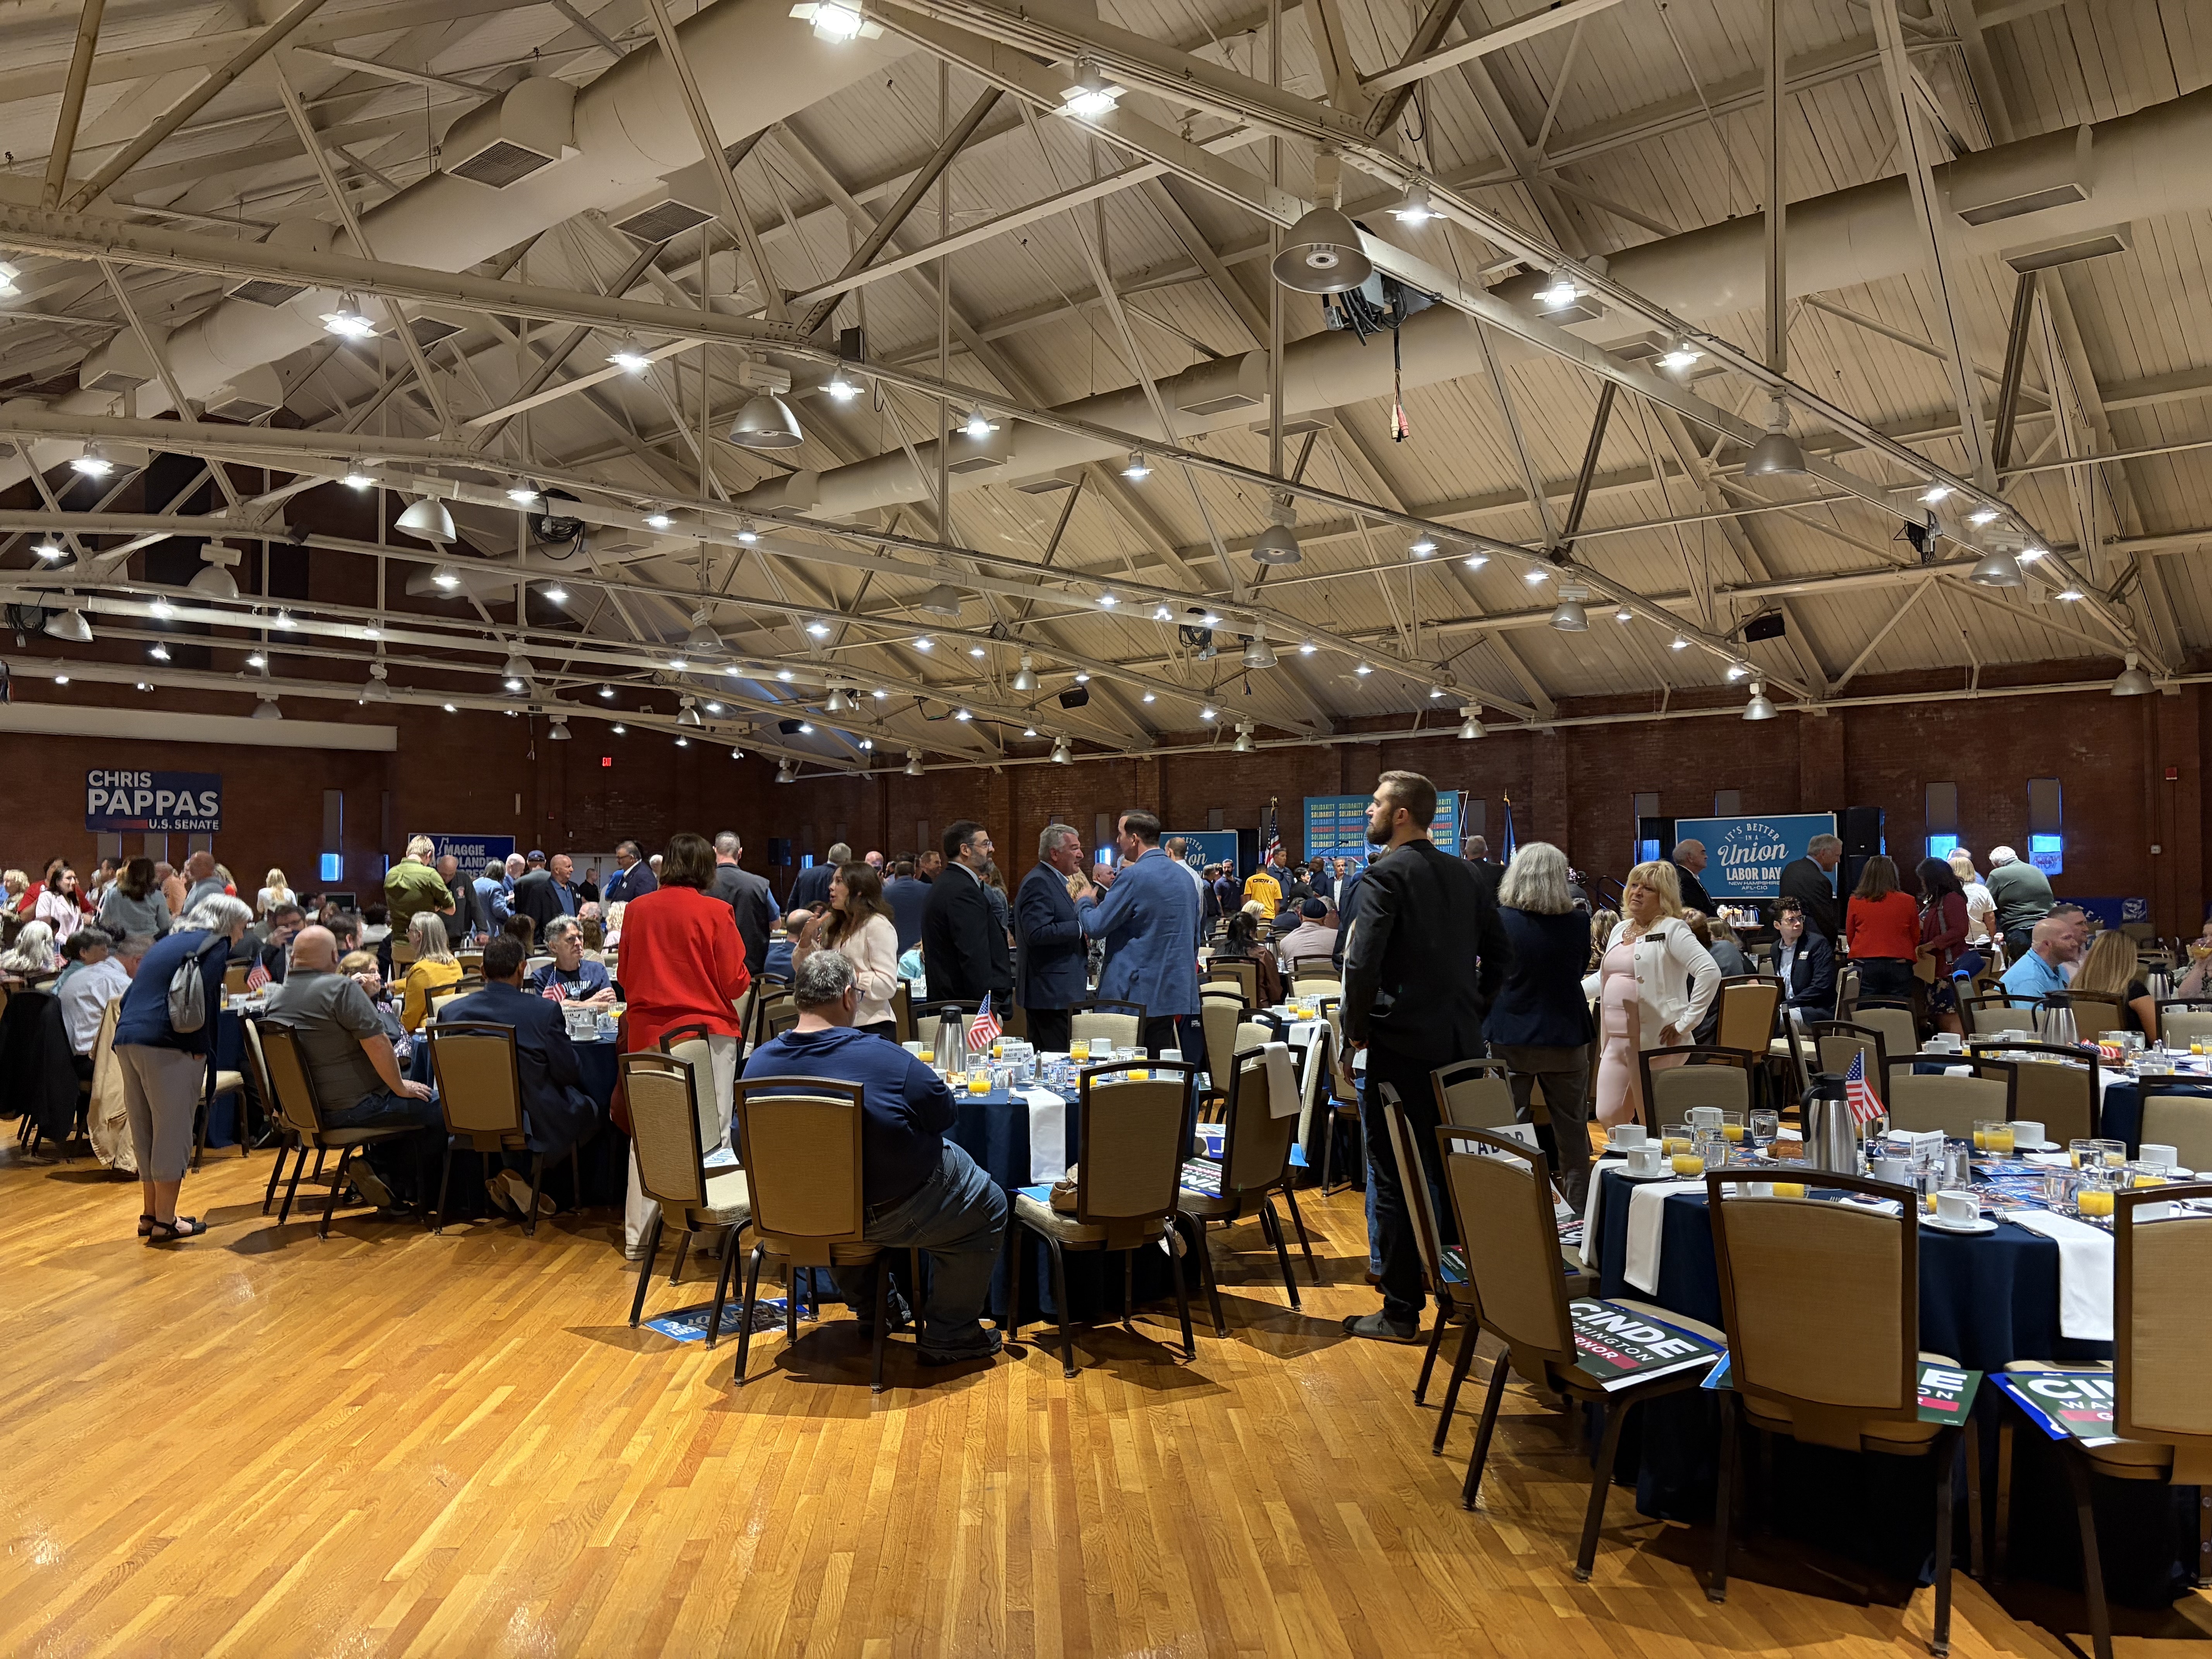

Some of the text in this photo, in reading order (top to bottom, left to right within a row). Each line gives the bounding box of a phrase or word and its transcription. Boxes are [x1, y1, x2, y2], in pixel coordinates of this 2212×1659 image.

[88, 770, 152, 788] CHRIS
[88, 788, 218, 817] PAPPAS
[149, 819, 219, 830] U.S. SENATE
[1724, 823, 1779, 842] IT'S BETTER
[444, 844, 485, 856] MAGGIE
[1717, 842, 1789, 866] Union
[1726, 867, 1781, 881] LABOR DAY
[1570, 1303, 1700, 1358] CINDE
